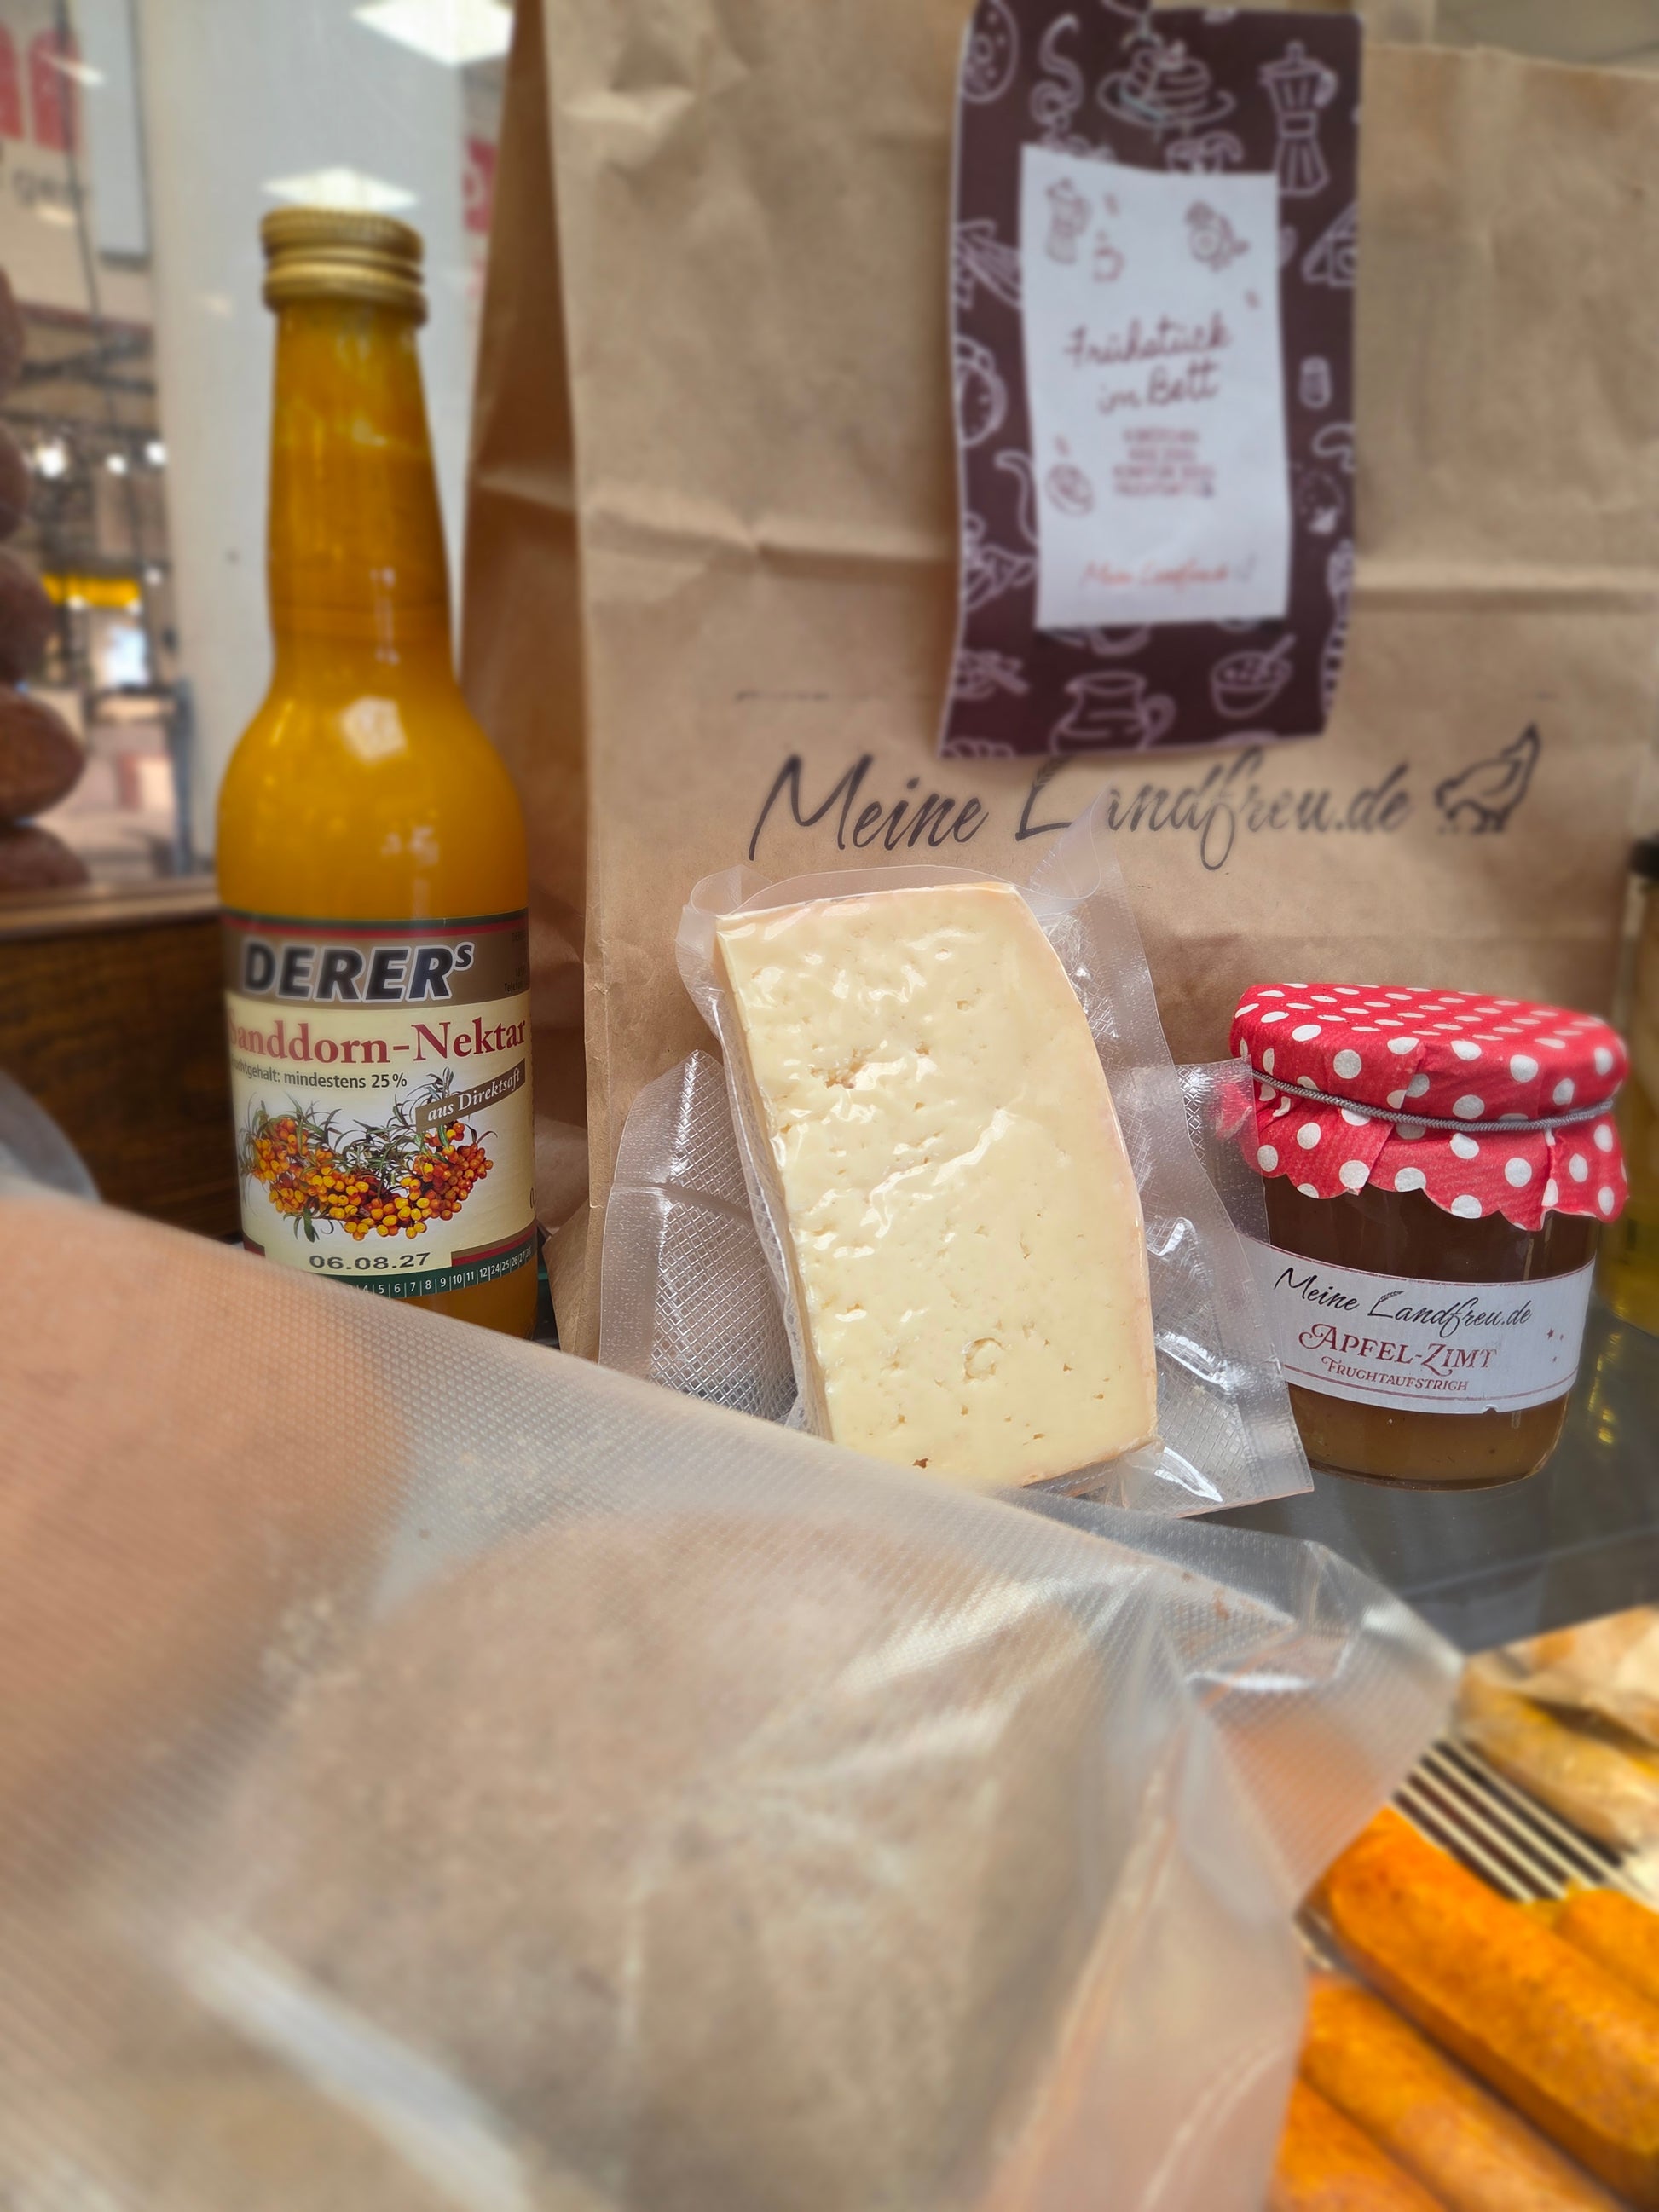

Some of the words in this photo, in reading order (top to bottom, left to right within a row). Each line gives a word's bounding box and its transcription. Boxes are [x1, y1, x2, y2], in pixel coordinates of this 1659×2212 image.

[748, 754, 989, 861] Meine
[284, 1071, 367, 1089] mindestens
[427, 1104, 454, 1122] aus
[458, 1070, 520, 1111] Direktsaft
[309, 1252, 431, 1270] 06.08.27
[378, 1284, 384, 1295] 5
[394, 1283, 401, 1293] 6
[410, 1282, 416, 1292] 7
[425, 1280, 431, 1291] 8
[440, 1278, 447, 1288] 9
[453, 1274, 462, 1285] 10
[466, 1272, 475, 1282] 11
[479, 1268, 488, 1279] 12
[491, 1264, 500, 1275] 24
[501, 1262, 510, 1272] 25
[1273, 1267, 1359, 1312] Meine
[1367, 1290, 1533, 1338] Landfreu.de
[1298, 1323, 1498, 1377] APFEL-ZIMT
[1321, 1356, 1468, 1391] FRUCHTAUFSTRICH
